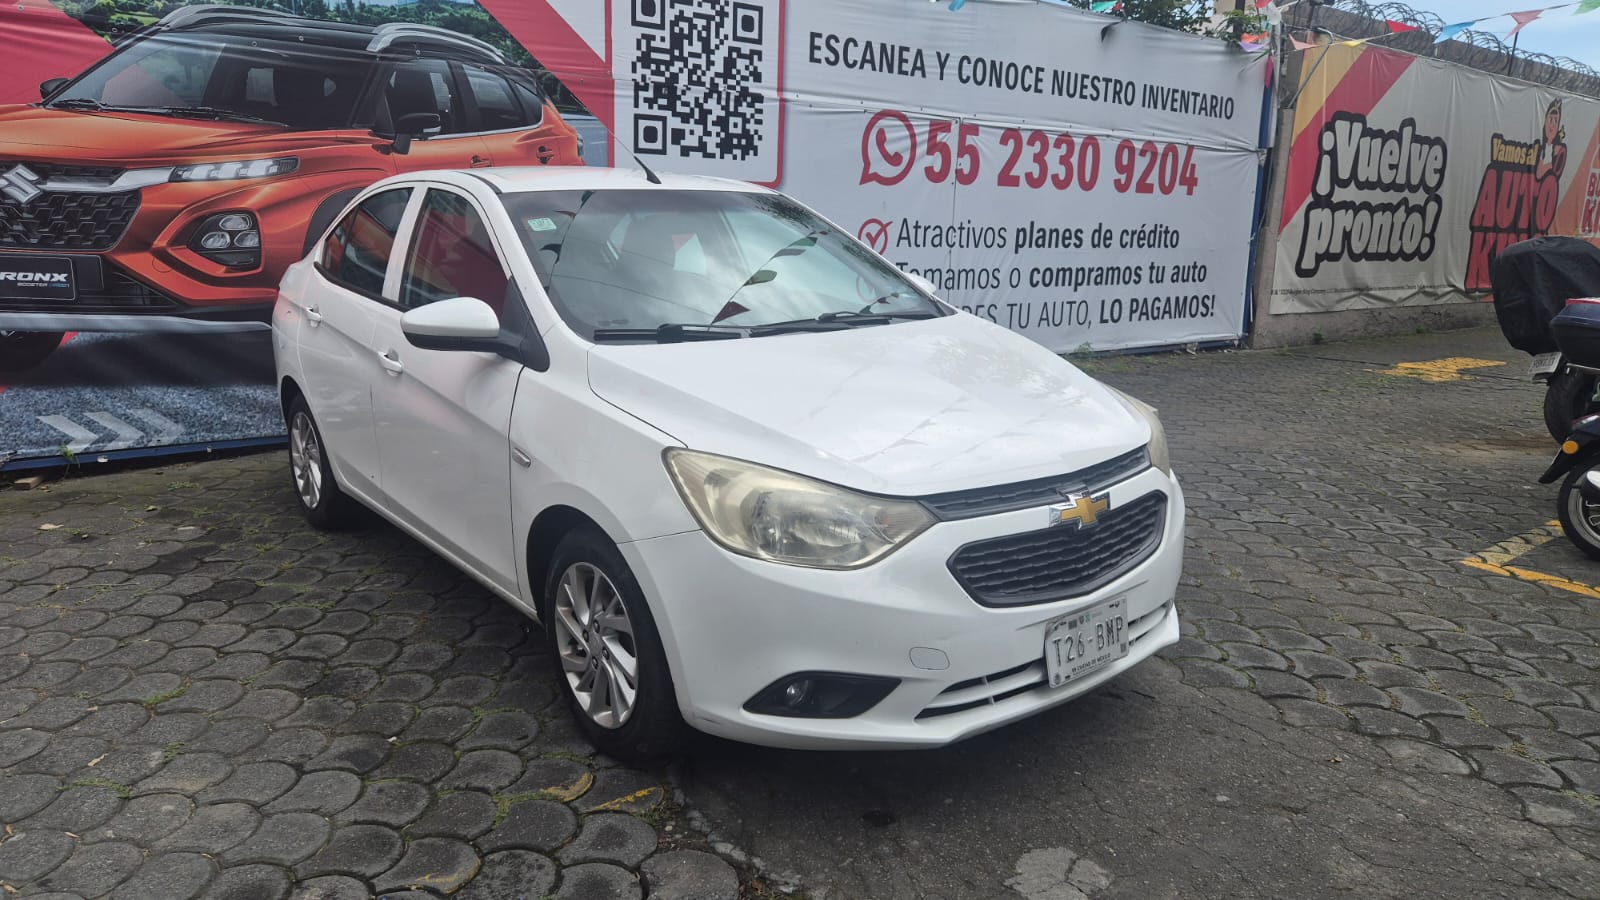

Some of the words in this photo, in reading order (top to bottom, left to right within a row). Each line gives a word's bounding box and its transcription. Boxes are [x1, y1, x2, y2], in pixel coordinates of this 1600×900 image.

[809, 32, 927, 78] ESCANEA
[936, 52, 951, 81] Y
[958, 56, 1045, 94] CONOCE
[1052, 70, 1136, 106] NUESTRO
[1142, 84, 1235, 120] INVENTARIO
[924, 121, 980, 185] 55
[997, 130, 1101, 191] 2330
[1113, 139, 1199, 196] 9204
[1314, 116, 1445, 197] ¡Vuelve
[1492, 137, 1527, 164] Vamos
[1470, 169, 1558, 231] AUTO
[897, 218, 1007, 249] Atractivos
[1014, 221, 1084, 254] planes
[1091, 223, 1113, 249] de
[1120, 223, 1181, 249] crédito
[1298, 199, 1440, 270] pronto!
[1011, 268, 1022, 289] o
[1030, 265, 1142, 293] compramos
[1149, 262, 1166, 285] tu
[1171, 262, 1208, 284] auto
[1007, 303, 1031, 329] TU
[1038, 301, 1093, 330] AUTO,
[1100, 300, 1123, 325] LO
[1130, 295, 1216, 322] PAGAMOS!
